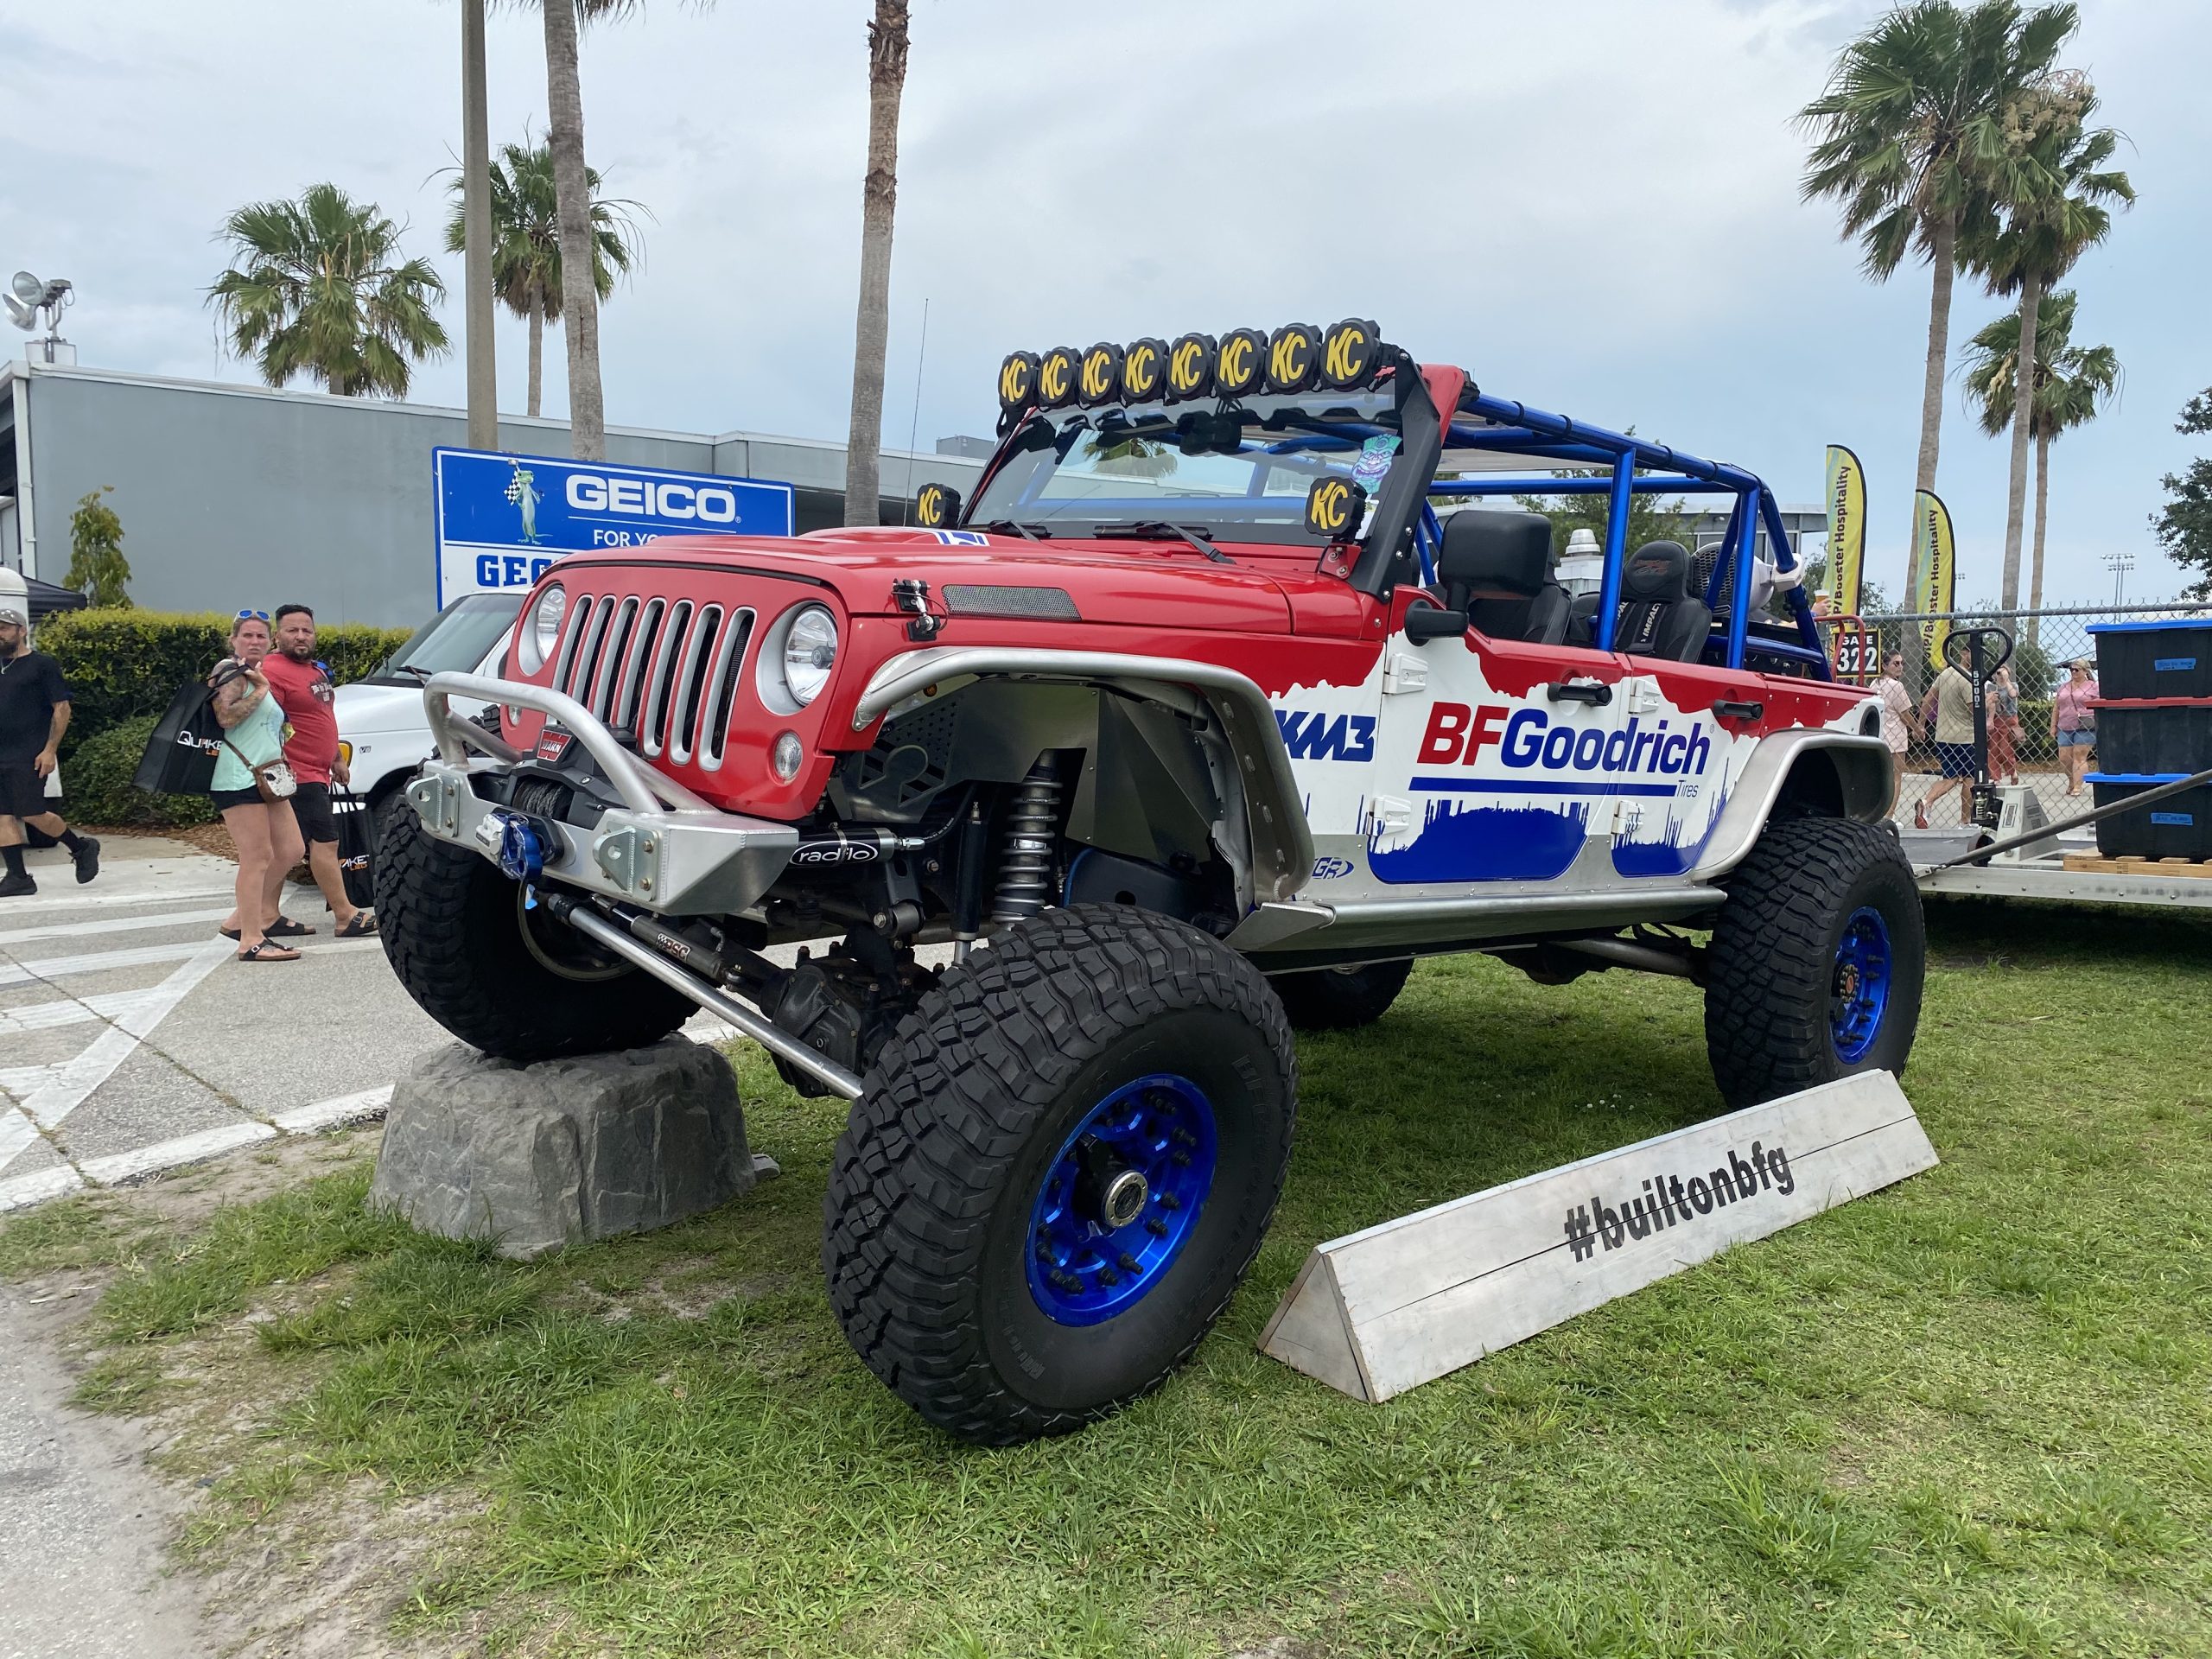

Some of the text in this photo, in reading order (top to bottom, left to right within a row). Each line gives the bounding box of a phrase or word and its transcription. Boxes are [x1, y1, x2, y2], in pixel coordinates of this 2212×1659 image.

[1041, 355, 1068, 399] KC
[1083, 351, 1110, 397] KC
[1125, 346, 1154, 393] KC
[1171, 341, 1202, 390] KC
[1219, 337, 1253, 386] KC
[1270, 332, 1306, 384] KC
[1325, 327, 1363, 380] KC
[1001, 358, 1027, 402] KC
[566, 474, 735, 523] GEICO
[918, 487, 942, 525] KC
[1310, 481, 1349, 529] KC
[594, 529, 630, 547] FOR
[1833, 466, 1851, 614] P/Booster Hospitality
[1929, 510, 1941, 581] Hospitality
[1837, 646, 1878, 671] 322
[1842, 635, 1873, 645] GAE
[1417, 701, 1710, 775] BFGoodrich
[1677, 779, 1699, 798] Tires
[338, 855, 367, 868] AKE
[798, 848, 870, 862] radlo
[1564, 1141, 1795, 1262] #builtonbfg
